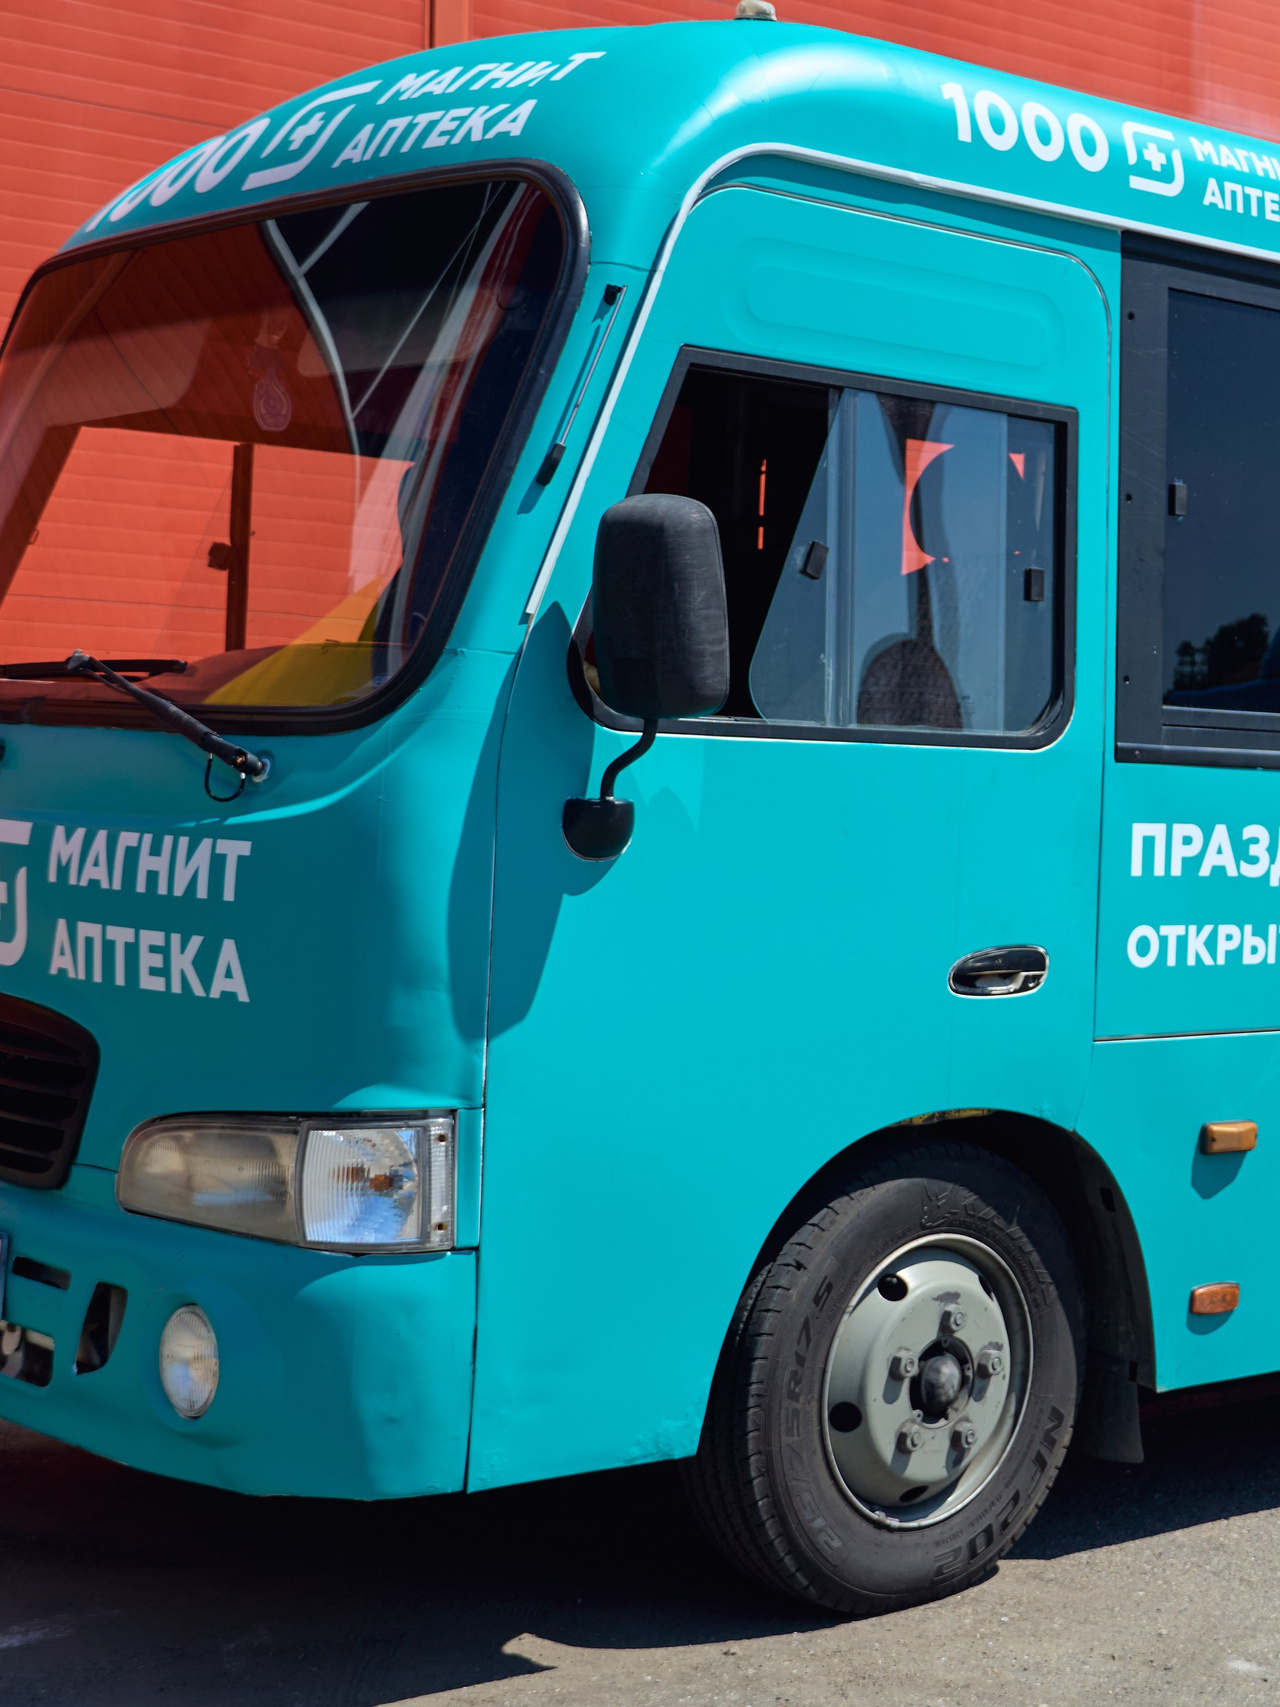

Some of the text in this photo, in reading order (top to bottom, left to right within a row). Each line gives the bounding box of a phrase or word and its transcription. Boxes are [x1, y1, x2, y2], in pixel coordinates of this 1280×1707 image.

[377, 52, 606, 105] МАГНИТ
[332, 99, 538, 169] АПТЕКА
[941, 82, 1109, 172] 1000
[85, 117, 271, 233] 1000
[48, 824, 252, 902] МАГНИТ
[48, 918, 251, 1003] АПТЕКА
